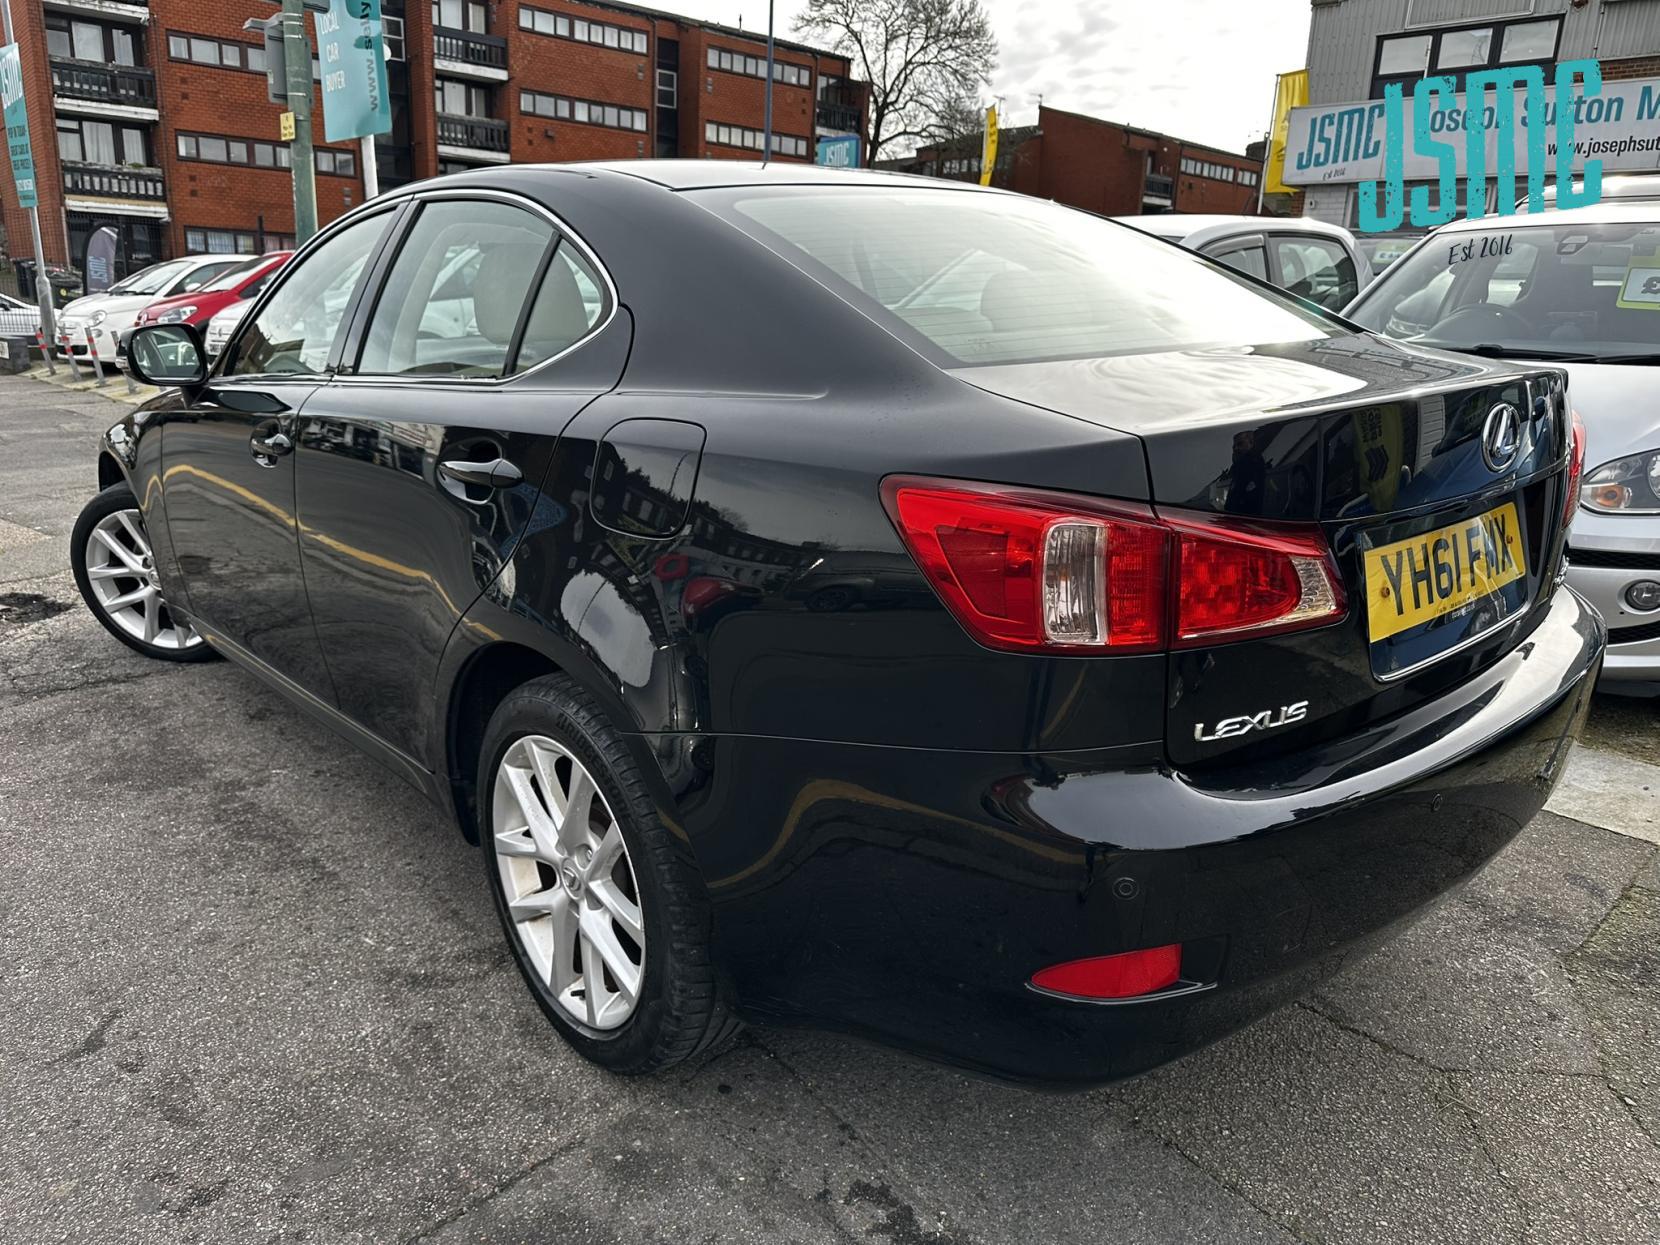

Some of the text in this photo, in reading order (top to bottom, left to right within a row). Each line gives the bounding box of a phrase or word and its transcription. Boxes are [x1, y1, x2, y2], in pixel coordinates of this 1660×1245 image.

[320, 11, 340, 35] LOCAL
[326, 42, 340, 63] CAR
[325, 70, 345, 93] BUYER
[1296, 103, 1385, 170] JSMC
[824, 140, 849, 167] JSMC
[1380, 533, 1463, 617] YH61
[1193, 700, 1309, 742] LEXUS
